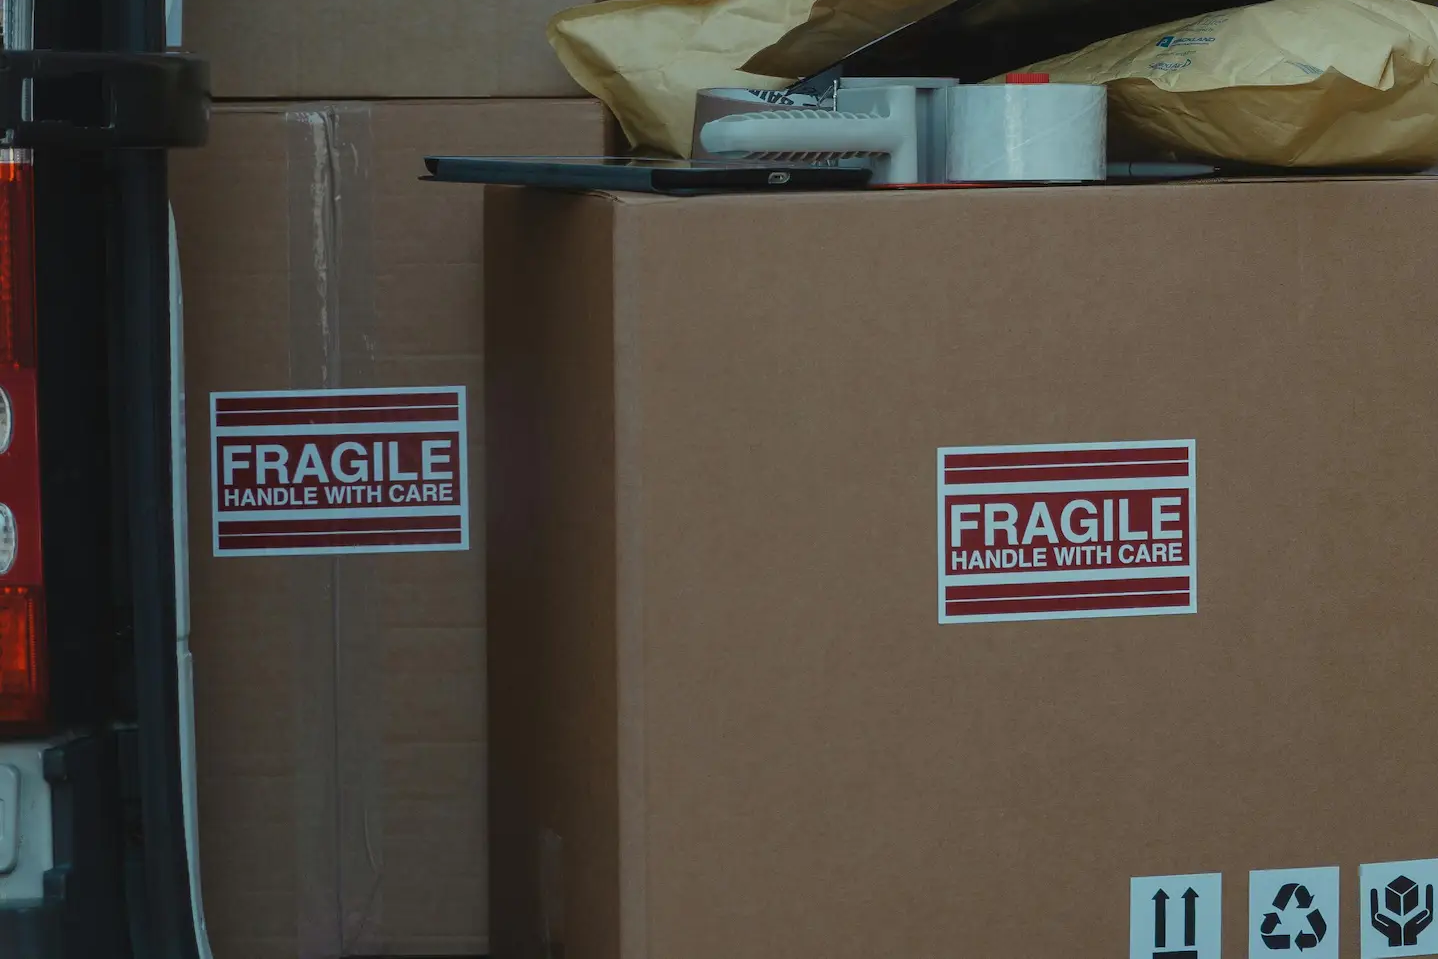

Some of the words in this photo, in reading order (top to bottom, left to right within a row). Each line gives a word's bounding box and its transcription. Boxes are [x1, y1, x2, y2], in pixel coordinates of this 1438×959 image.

[223, 440, 453, 486] FRAGILE
[224, 487, 318, 507] HANDLE
[324, 485, 382, 504] WITH
[388, 483, 453, 503] CARE
[951, 497, 1183, 548] FRAGILE
[951, 547, 1048, 571] HANDLE
[1053, 545, 1112, 567] WITH
[1118, 542, 1183, 564] CARE
